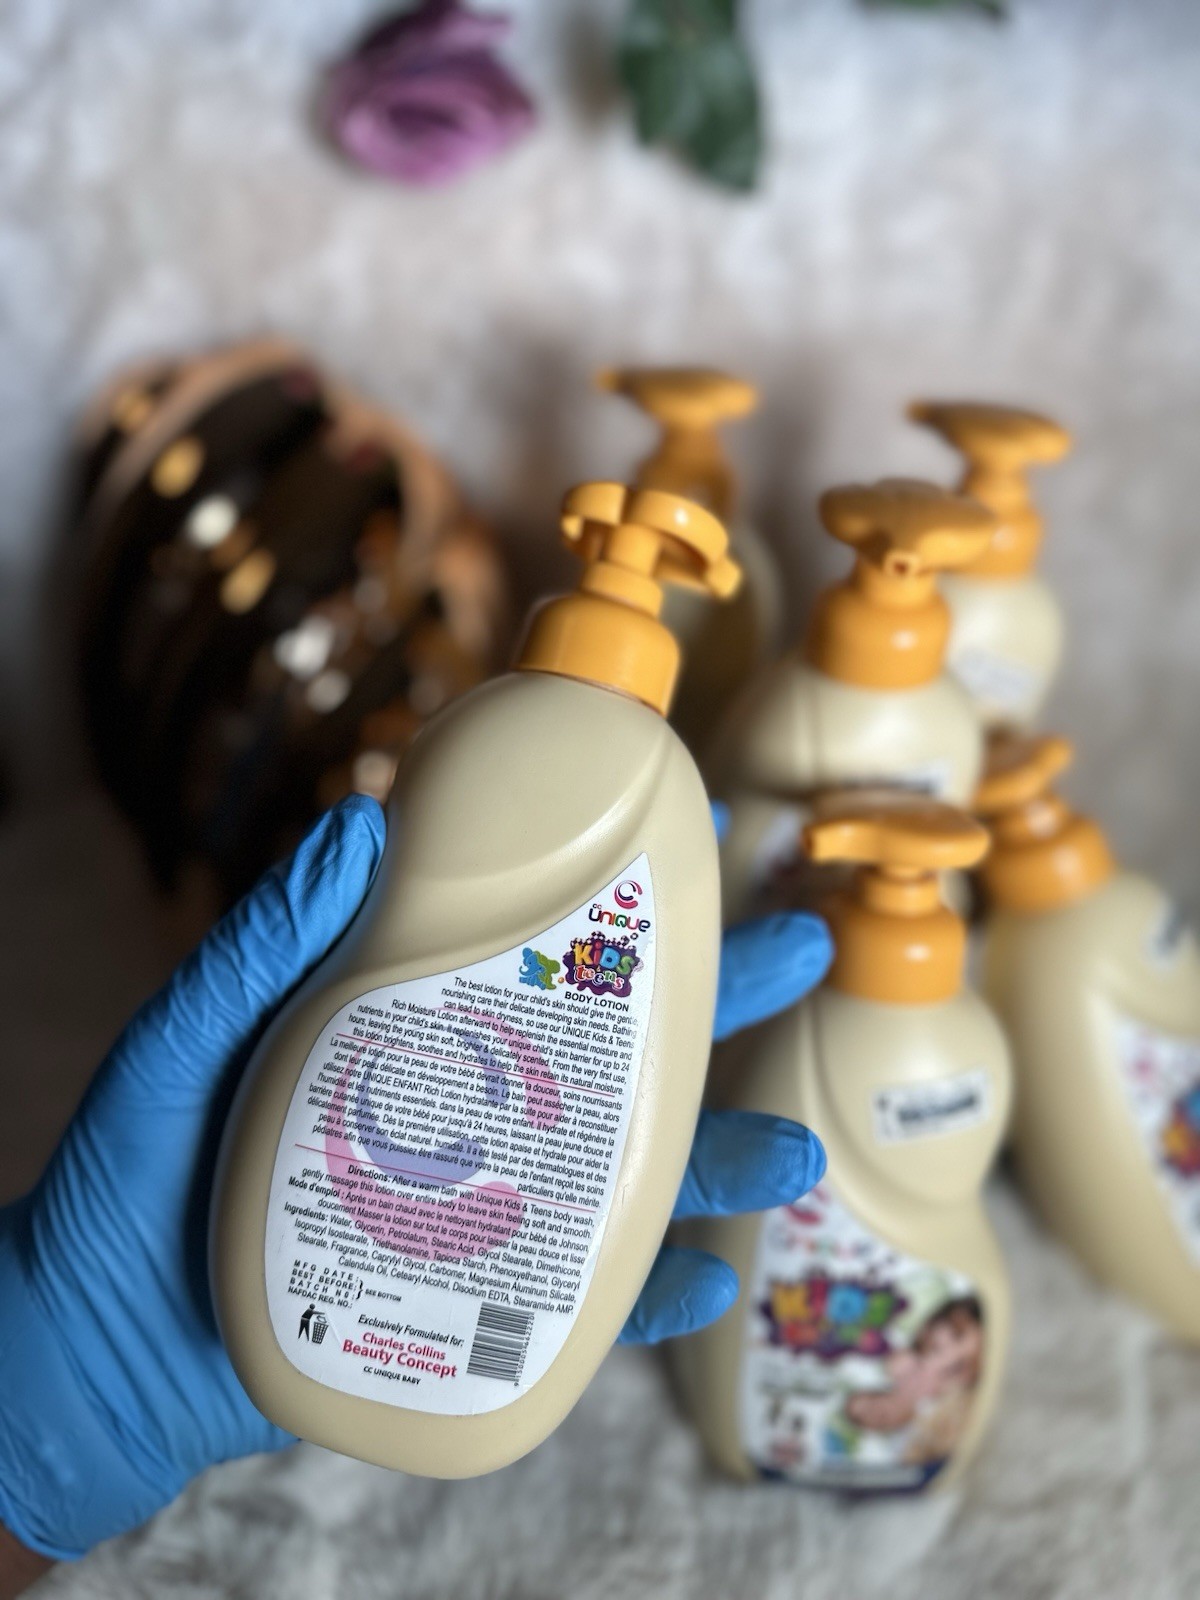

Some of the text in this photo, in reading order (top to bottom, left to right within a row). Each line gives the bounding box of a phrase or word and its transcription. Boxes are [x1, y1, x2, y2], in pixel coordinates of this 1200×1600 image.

[441, 988, 476, 1003] nourishing
[476, 995, 492, 1005] care
[493, 997, 508, 1008] their
[508, 1001, 535, 1014] delicate
[536, 1008, 572, 1025] developing
[573, 1016, 587, 1026] skin
[454, 976, 638, 1026] The best lotion for your child's skin should give the gente,
[565, 992, 630, 1012] BODY LOTION
[391, 999, 632, 1060] Rich Moisture Lotion afterward to help replenish the essential moisture and
[330, 1037, 338, 1046] La
[367, 1045, 385, 1057] lotion
[385, 1052, 402, 1062] pour
[403, 1054, 409, 1063] la
[410, 1058, 428, 1068] peau
[429, 1060, 438, 1069] de
[439, 1064, 456, 1073] votre
[457, 1066, 475, 1077] bébé
[476, 1070, 499, 1083] devrait
[500, 1076, 524, 1088] donner
[524, 1081, 531, 1090] la
[562, 1091, 580, 1101] soins
[323, 1062, 344, 1073] utilisez
[344, 1067, 362, 1077] notre
[363, 1070, 392, 1085] UNIQUE
[392, 1077, 423, 1091] ENFANT
[423, 1084, 439, 1095] Rich
[440, 1087, 461, 1099] Lotion
[462, 1092, 498, 1108] hydratante
[498, 1102, 511, 1111] par
[511, 1103, 518, 1112] la
[519, 1106, 536, 1116] suite
[536, 1110, 553, 1119] pour
[553, 1113, 571, 1123] aider
[301, 1167, 324, 1181] gently
[324, 1174, 358, 1188] massage
[359, 1180, 373, 1191] this
[374, 1183, 395, 1196] lotion
[396, 1190, 414, 1199] over
[415, 1194, 436, 1205] entire
[437, 1197, 457, 1211] body
[457, 1201, 465, 1211] to
[466, 1204, 487, 1216] leave
[488, 1209, 504, 1219] skin
[505, 1212, 530, 1228] feeling
[531, 1219, 546, 1229] soft
[546, 1223, 562, 1232] and
[391, 1175, 410, 1186] After
[418, 1182, 439, 1192] warm
[440, 1185, 457, 1196] bath
[459, 1190, 474, 1200] with
[475, 1193, 502, 1206] Unique
[503, 1199, 520, 1210] Kids
[530, 1204, 552, 1217] Teens
[553, 1210, 572, 1223] body
[516, 1183, 553, 1197] particuliers
[554, 1191, 577, 1202] qu'elle
[294, 1218, 327, 1235] Isopropyl
[433, 1249, 460, 1264] Tapioca
[550, 1276, 580, 1291] Glyceryl
[430, 1236, 456, 1249] Stearic
[477, 1246, 500, 1260] Glycol
[290, 1277, 328, 1292] BATCH
[291, 1268, 314, 1279] BEST
[338, 1256, 374, 1271] Calendula
[390, 1267, 421, 1283] Cetearyl
[452, 1281, 486, 1296] Disodium
[513, 1295, 554, 1311] Stearamide
[468, 1271, 510, 1289] Magnesium
[511, 1281, 547, 1296] Aluminum
[287, 1286, 317, 1299] NAFDAC
[377, 1291, 401, 1301] BOTTOM
[358, 1314, 464, 1347] Exclusively Formulated for:
[362, 1332, 445, 1360] Charles Collins
[342, 1339, 456, 1378] Beauty Concept
[373, 1368, 400, 1380] UNIQUE
[401, 1374, 420, 1384] BABY
